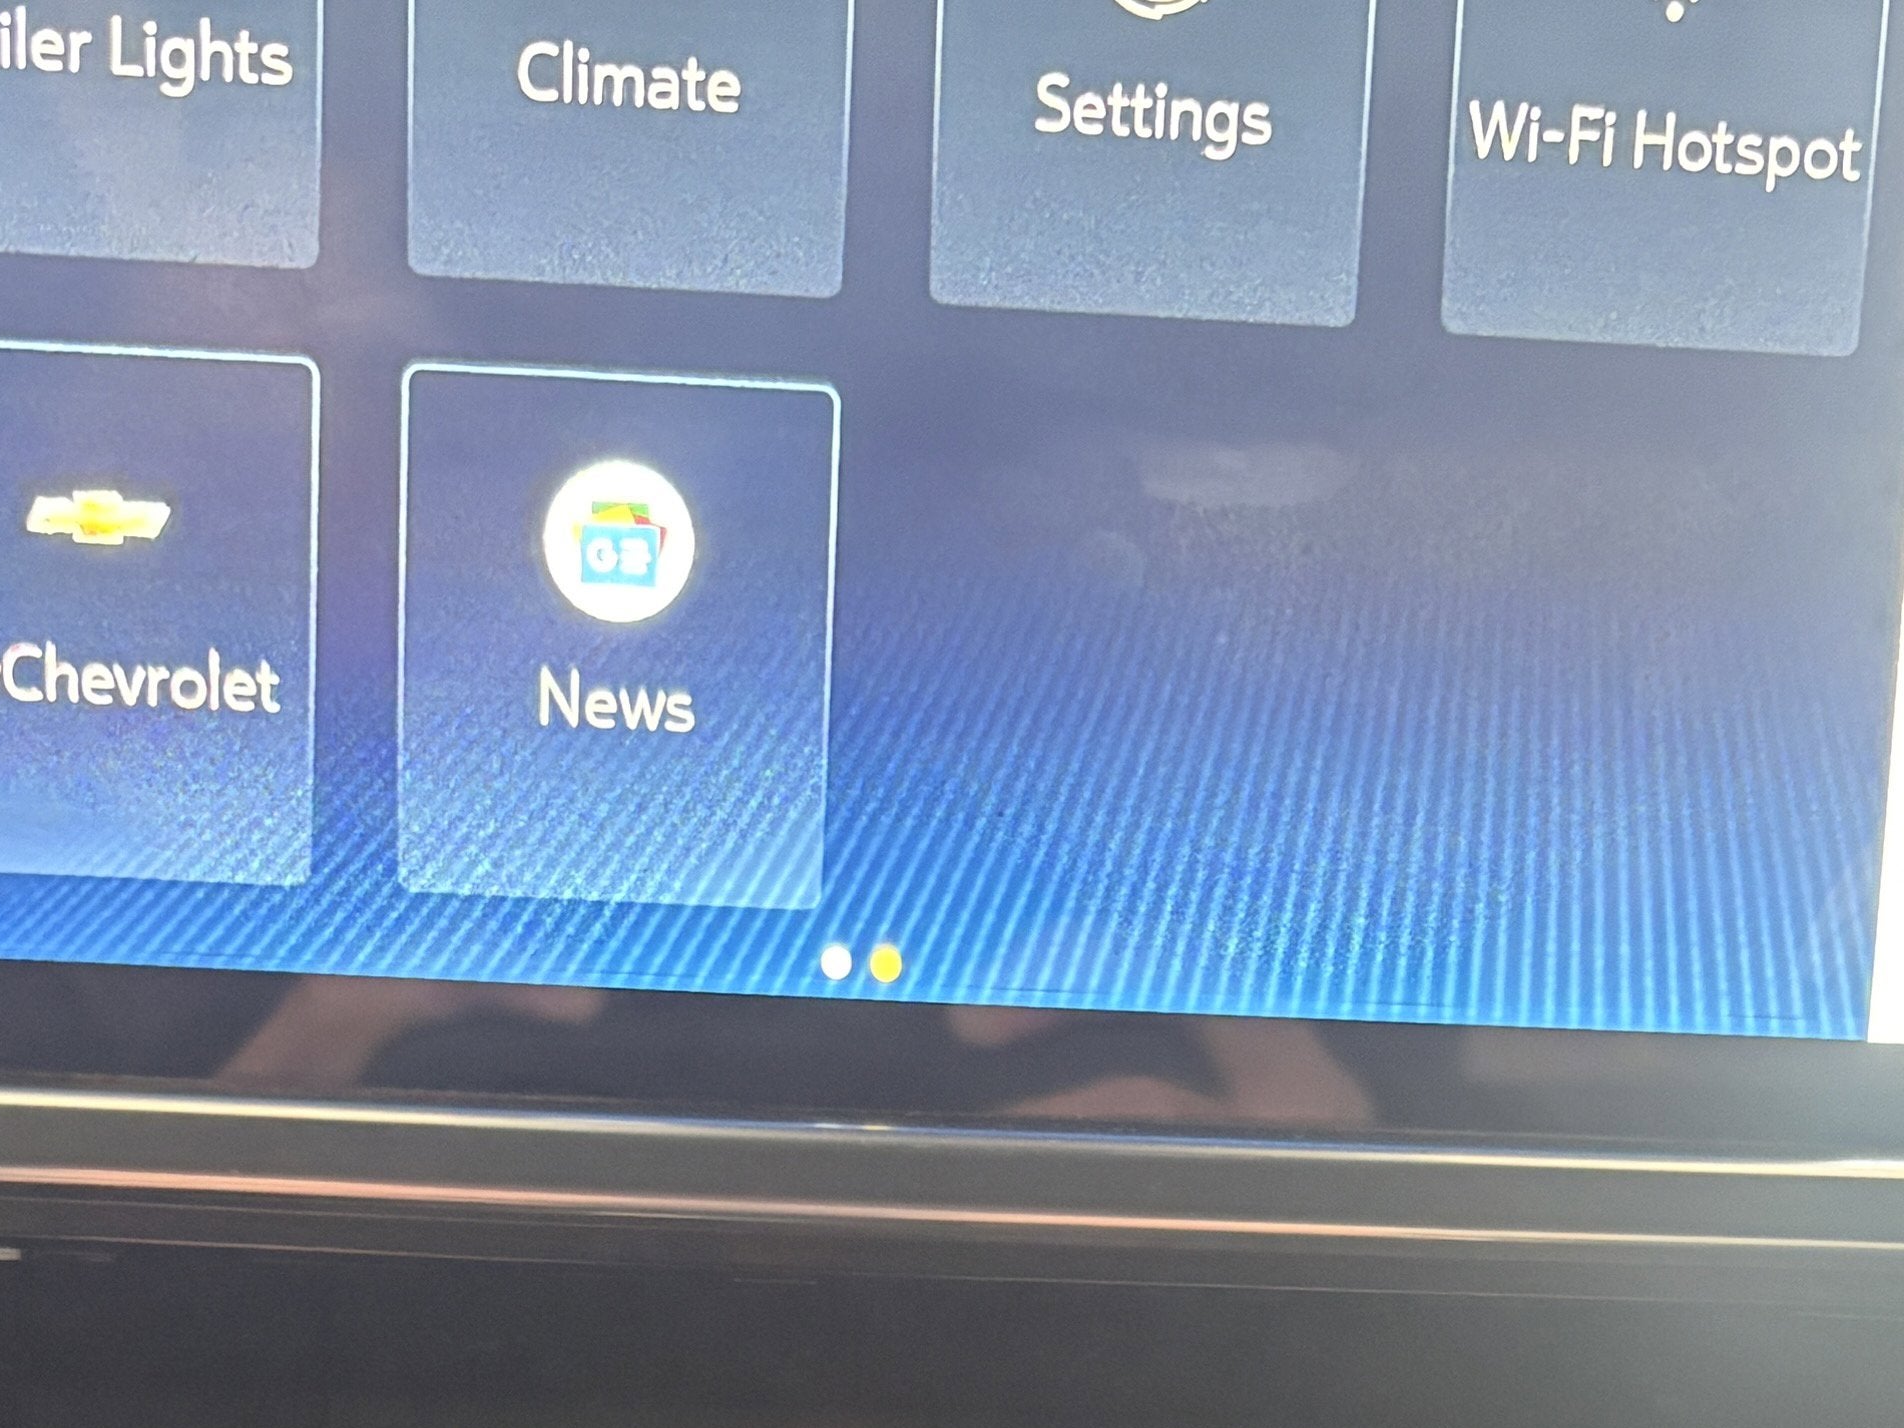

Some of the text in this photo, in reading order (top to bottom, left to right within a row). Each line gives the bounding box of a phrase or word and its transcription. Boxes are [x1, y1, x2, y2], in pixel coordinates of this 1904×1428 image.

[110, 14, 294, 98] Lights
[516, 42, 742, 114] Climate
[1034, 73, 1273, 160] Settings
[1468, 99, 1863, 191] Wi-Fi Hotspot
[536, 668, 696, 732] News
